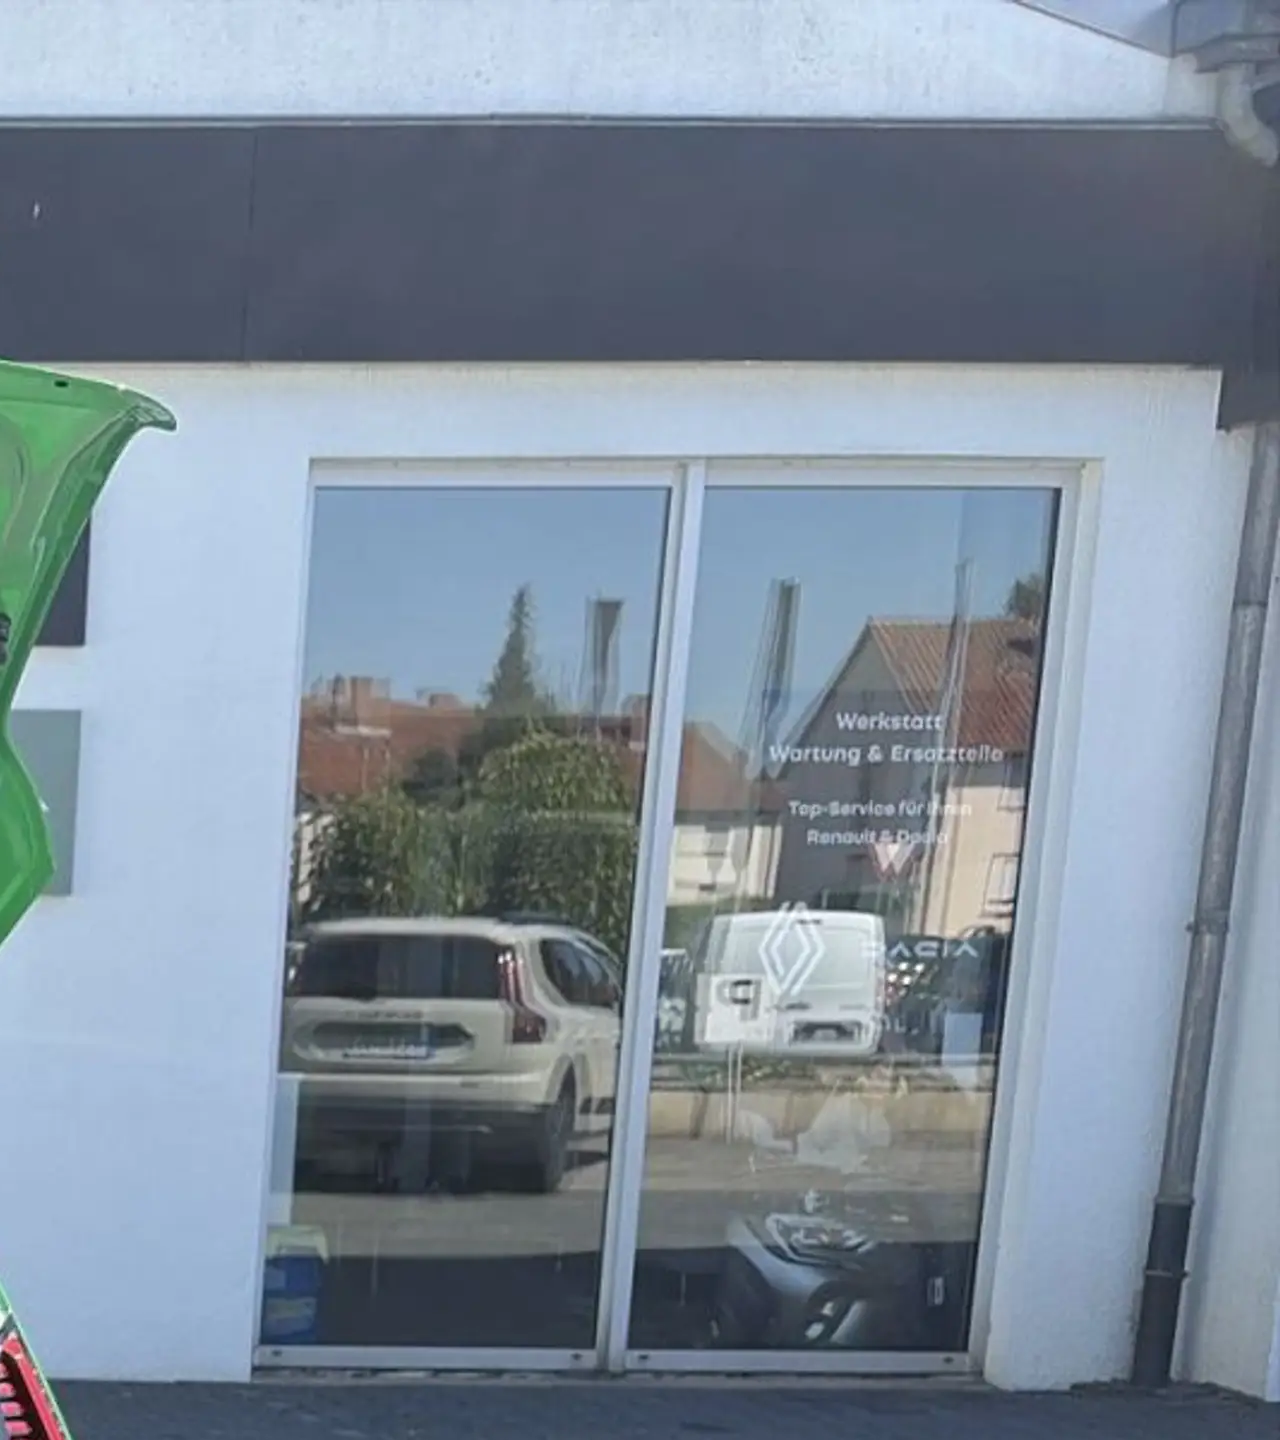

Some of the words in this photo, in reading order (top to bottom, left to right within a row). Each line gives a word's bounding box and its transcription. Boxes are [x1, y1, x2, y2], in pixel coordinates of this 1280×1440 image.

[836, 711, 944, 732] Werkstatt
[769, 744, 862, 767] Wartung
[866, 744, 884, 763] &
[890, 744, 1004, 764] Ersatzteile
[788, 800, 896, 820] Top-Service
[899, 799, 924, 817] für
[807, 828, 876, 846] Renault
